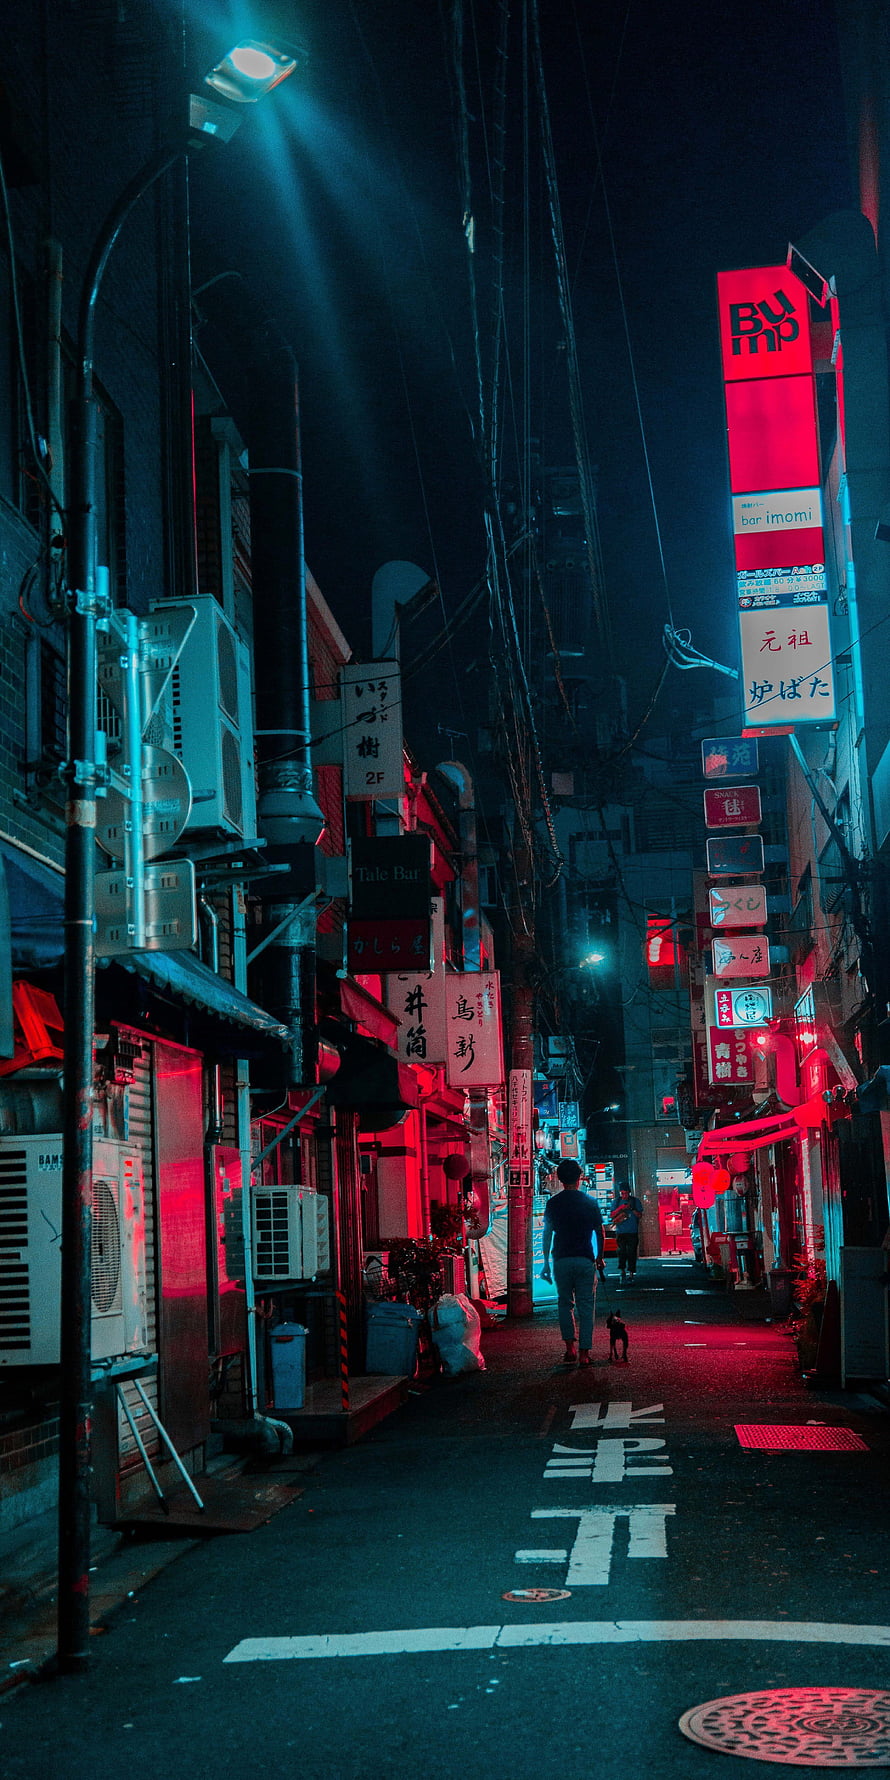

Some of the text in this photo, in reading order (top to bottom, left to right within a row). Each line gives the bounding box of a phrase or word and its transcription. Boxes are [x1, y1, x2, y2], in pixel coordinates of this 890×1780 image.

[729, 289, 799, 355] Bump
[741, 507, 812, 526] bar imomi
[759, 629, 813, 652] 元祖
[749, 676, 830, 704] 炉ばた
[366, 772, 385, 785] 2F
[714, 790, 739, 799] SNACK
[355, 865, 421, 882] Tale Bar
[716, 897, 761, 911] つくし
[485, 981, 495, 1009] 水たき
[404, 984, 428, 1060] 井筒
[475, 992, 484, 1028] やきとり
[734, 1029, 749, 1078] もつやき
